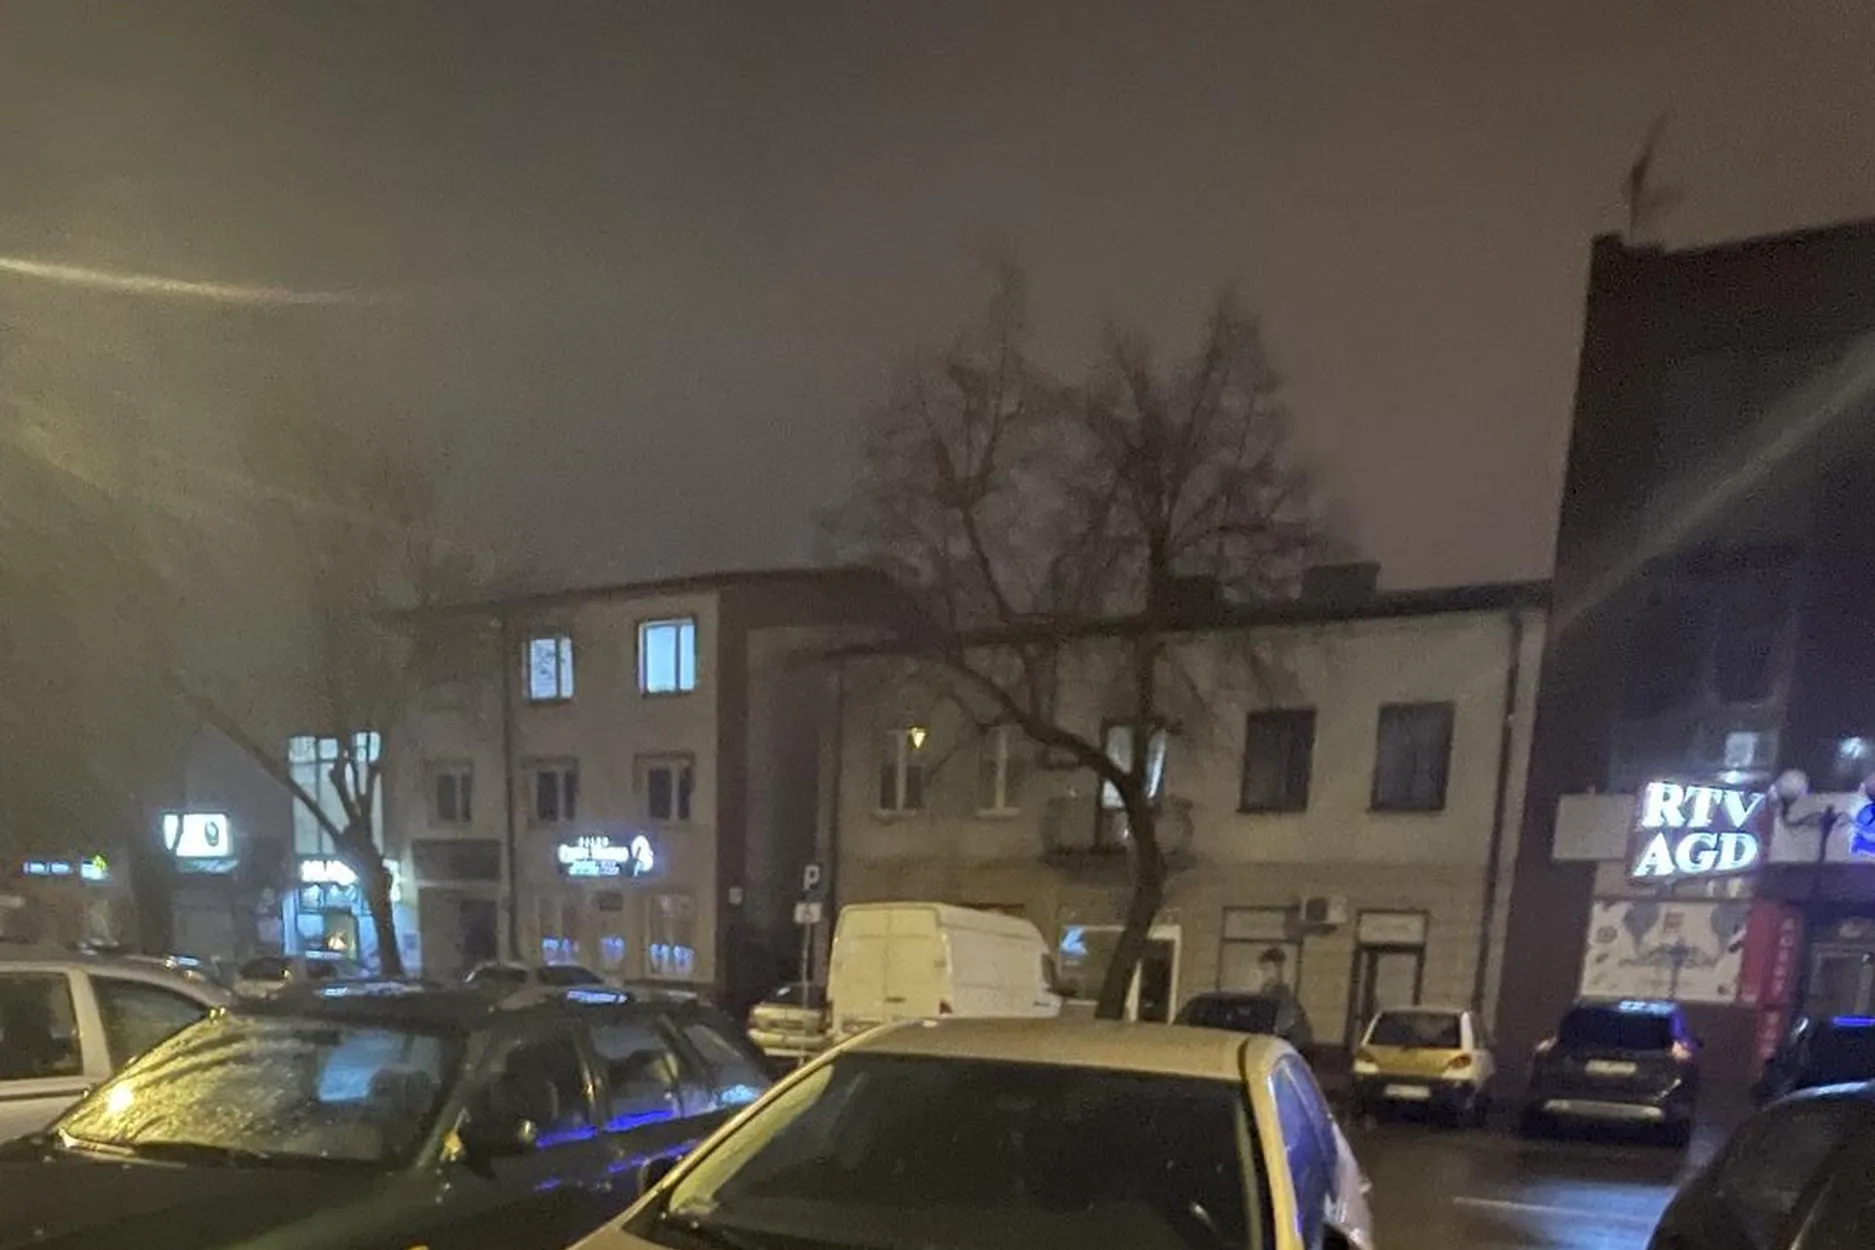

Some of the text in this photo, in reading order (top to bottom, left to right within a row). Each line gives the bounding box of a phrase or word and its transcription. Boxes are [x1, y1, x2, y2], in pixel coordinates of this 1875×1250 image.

[1641, 781, 1764, 829] RTV
[1633, 832, 1759, 877] AGD
[804, 865, 820, 890] P
